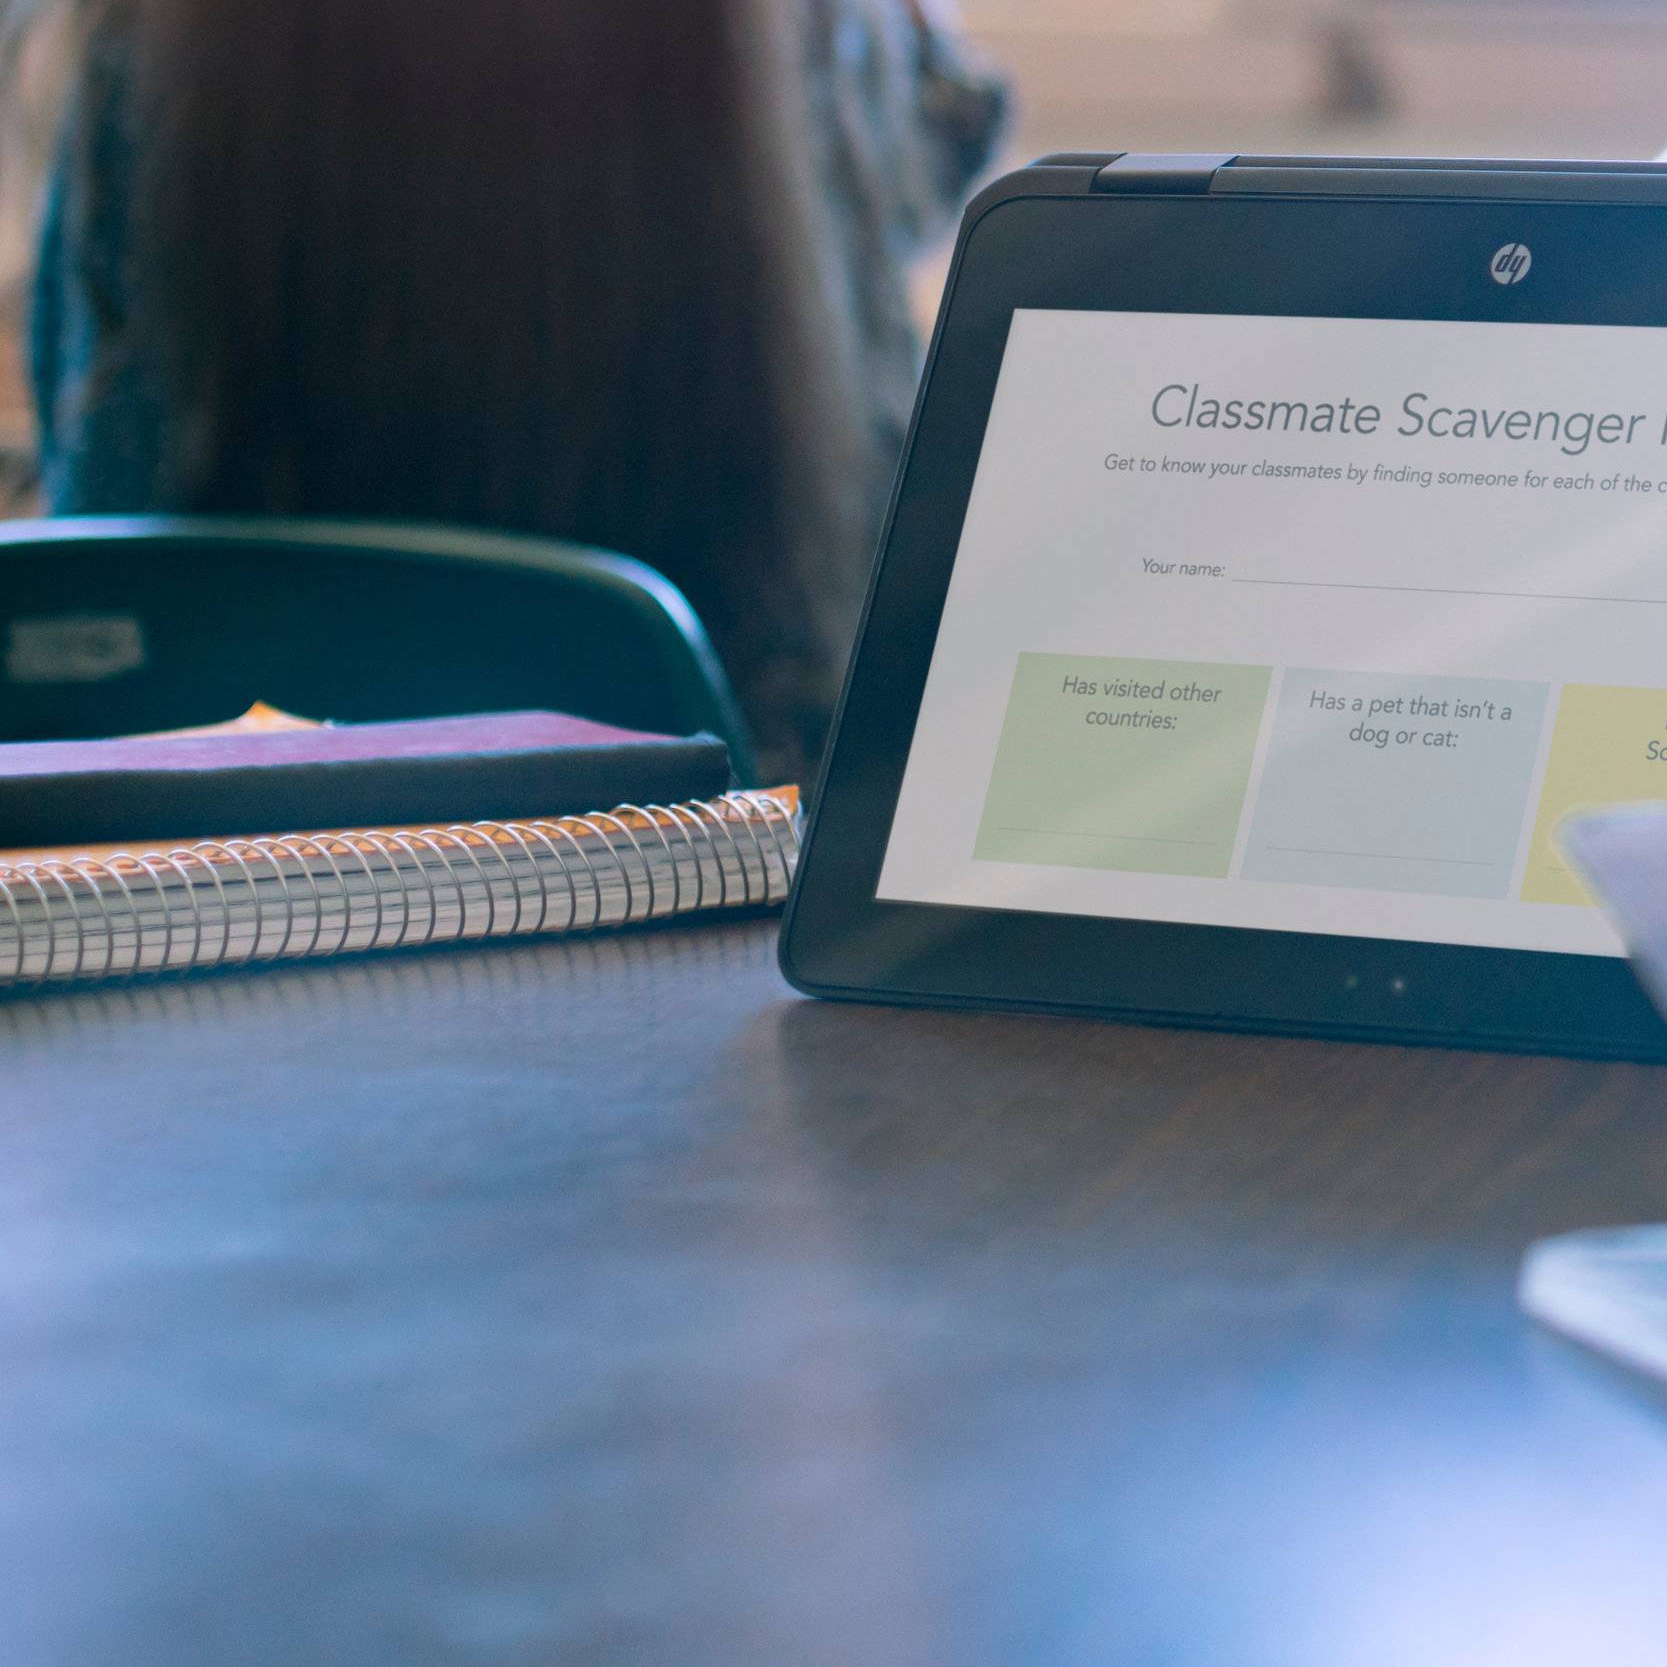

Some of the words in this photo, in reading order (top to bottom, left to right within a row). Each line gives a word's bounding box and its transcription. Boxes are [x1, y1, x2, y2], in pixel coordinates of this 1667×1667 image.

[1150, 382, 1382, 436] Classmate
[1396, 391, 1648, 457] Scavenger
[1103, 452, 1137, 473] Get
[1139, 455, 1158, 473] to
[1160, 454, 1207, 475] know
[1207, 461, 1249, 480] your
[1250, 458, 1343, 481] classmates
[1345, 462, 1370, 486] by
[1372, 462, 1434, 489] finding
[1436, 470, 1519, 488] someone
[1522, 468, 1550, 489] for
[1552, 471, 1595, 492] each
[1598, 472, 1623, 493] of
[1623, 473, 1653, 494] the
[1142, 557, 1177, 575] Your
[1178, 562, 1226, 578] name:
[1061, 675, 1098, 696] Has
[1102, 679, 1166, 700] visited
[1169, 681, 1223, 703] other
[1085, 709, 1178, 731] countries:
[1309, 690, 1346, 711] Has
[1351, 697, 1364, 712] a
[1367, 696, 1405, 719] pet
[1407, 694, 1450, 718] that
[1453, 699, 1496, 721] isn't
[1499, 706, 1513, 722] a
[1348, 720, 1391, 750] dog
[1394, 728, 1419, 745] or
[1421, 730, 1459, 749] cat:
